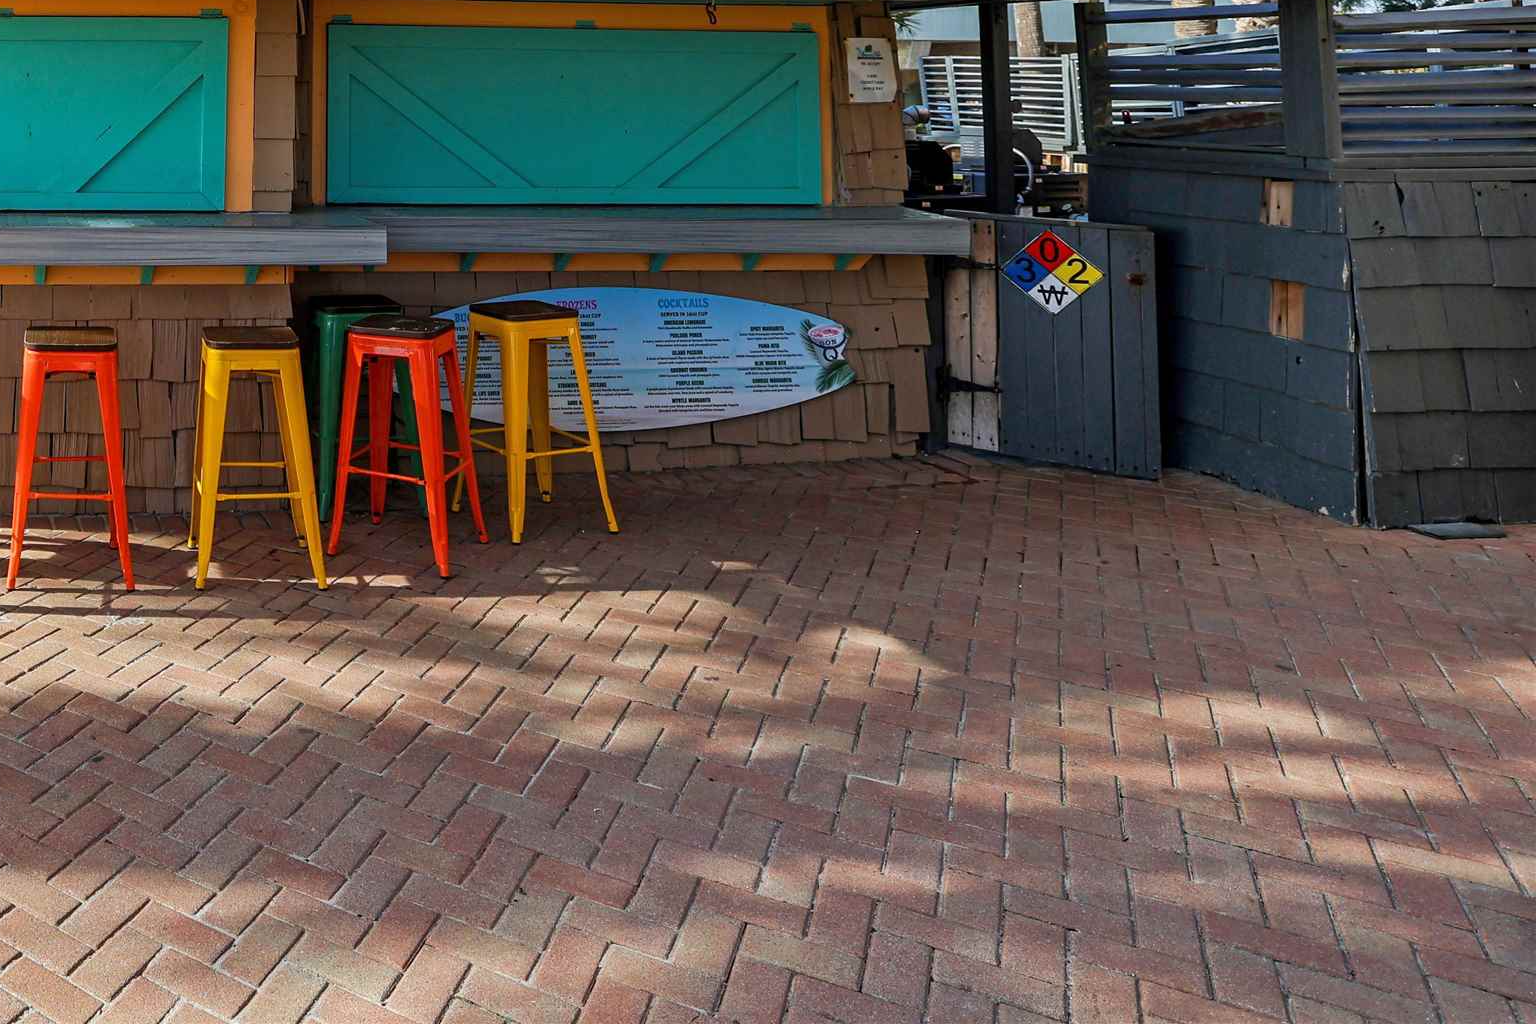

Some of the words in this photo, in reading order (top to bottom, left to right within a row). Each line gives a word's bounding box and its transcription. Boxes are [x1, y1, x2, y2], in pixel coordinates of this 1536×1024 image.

[1039, 237, 1060, 263] 0
[1015, 256, 1036, 285] 3
[1067, 258, 1090, 285] 2
[657, 297, 710, 308] COCKTAILS
